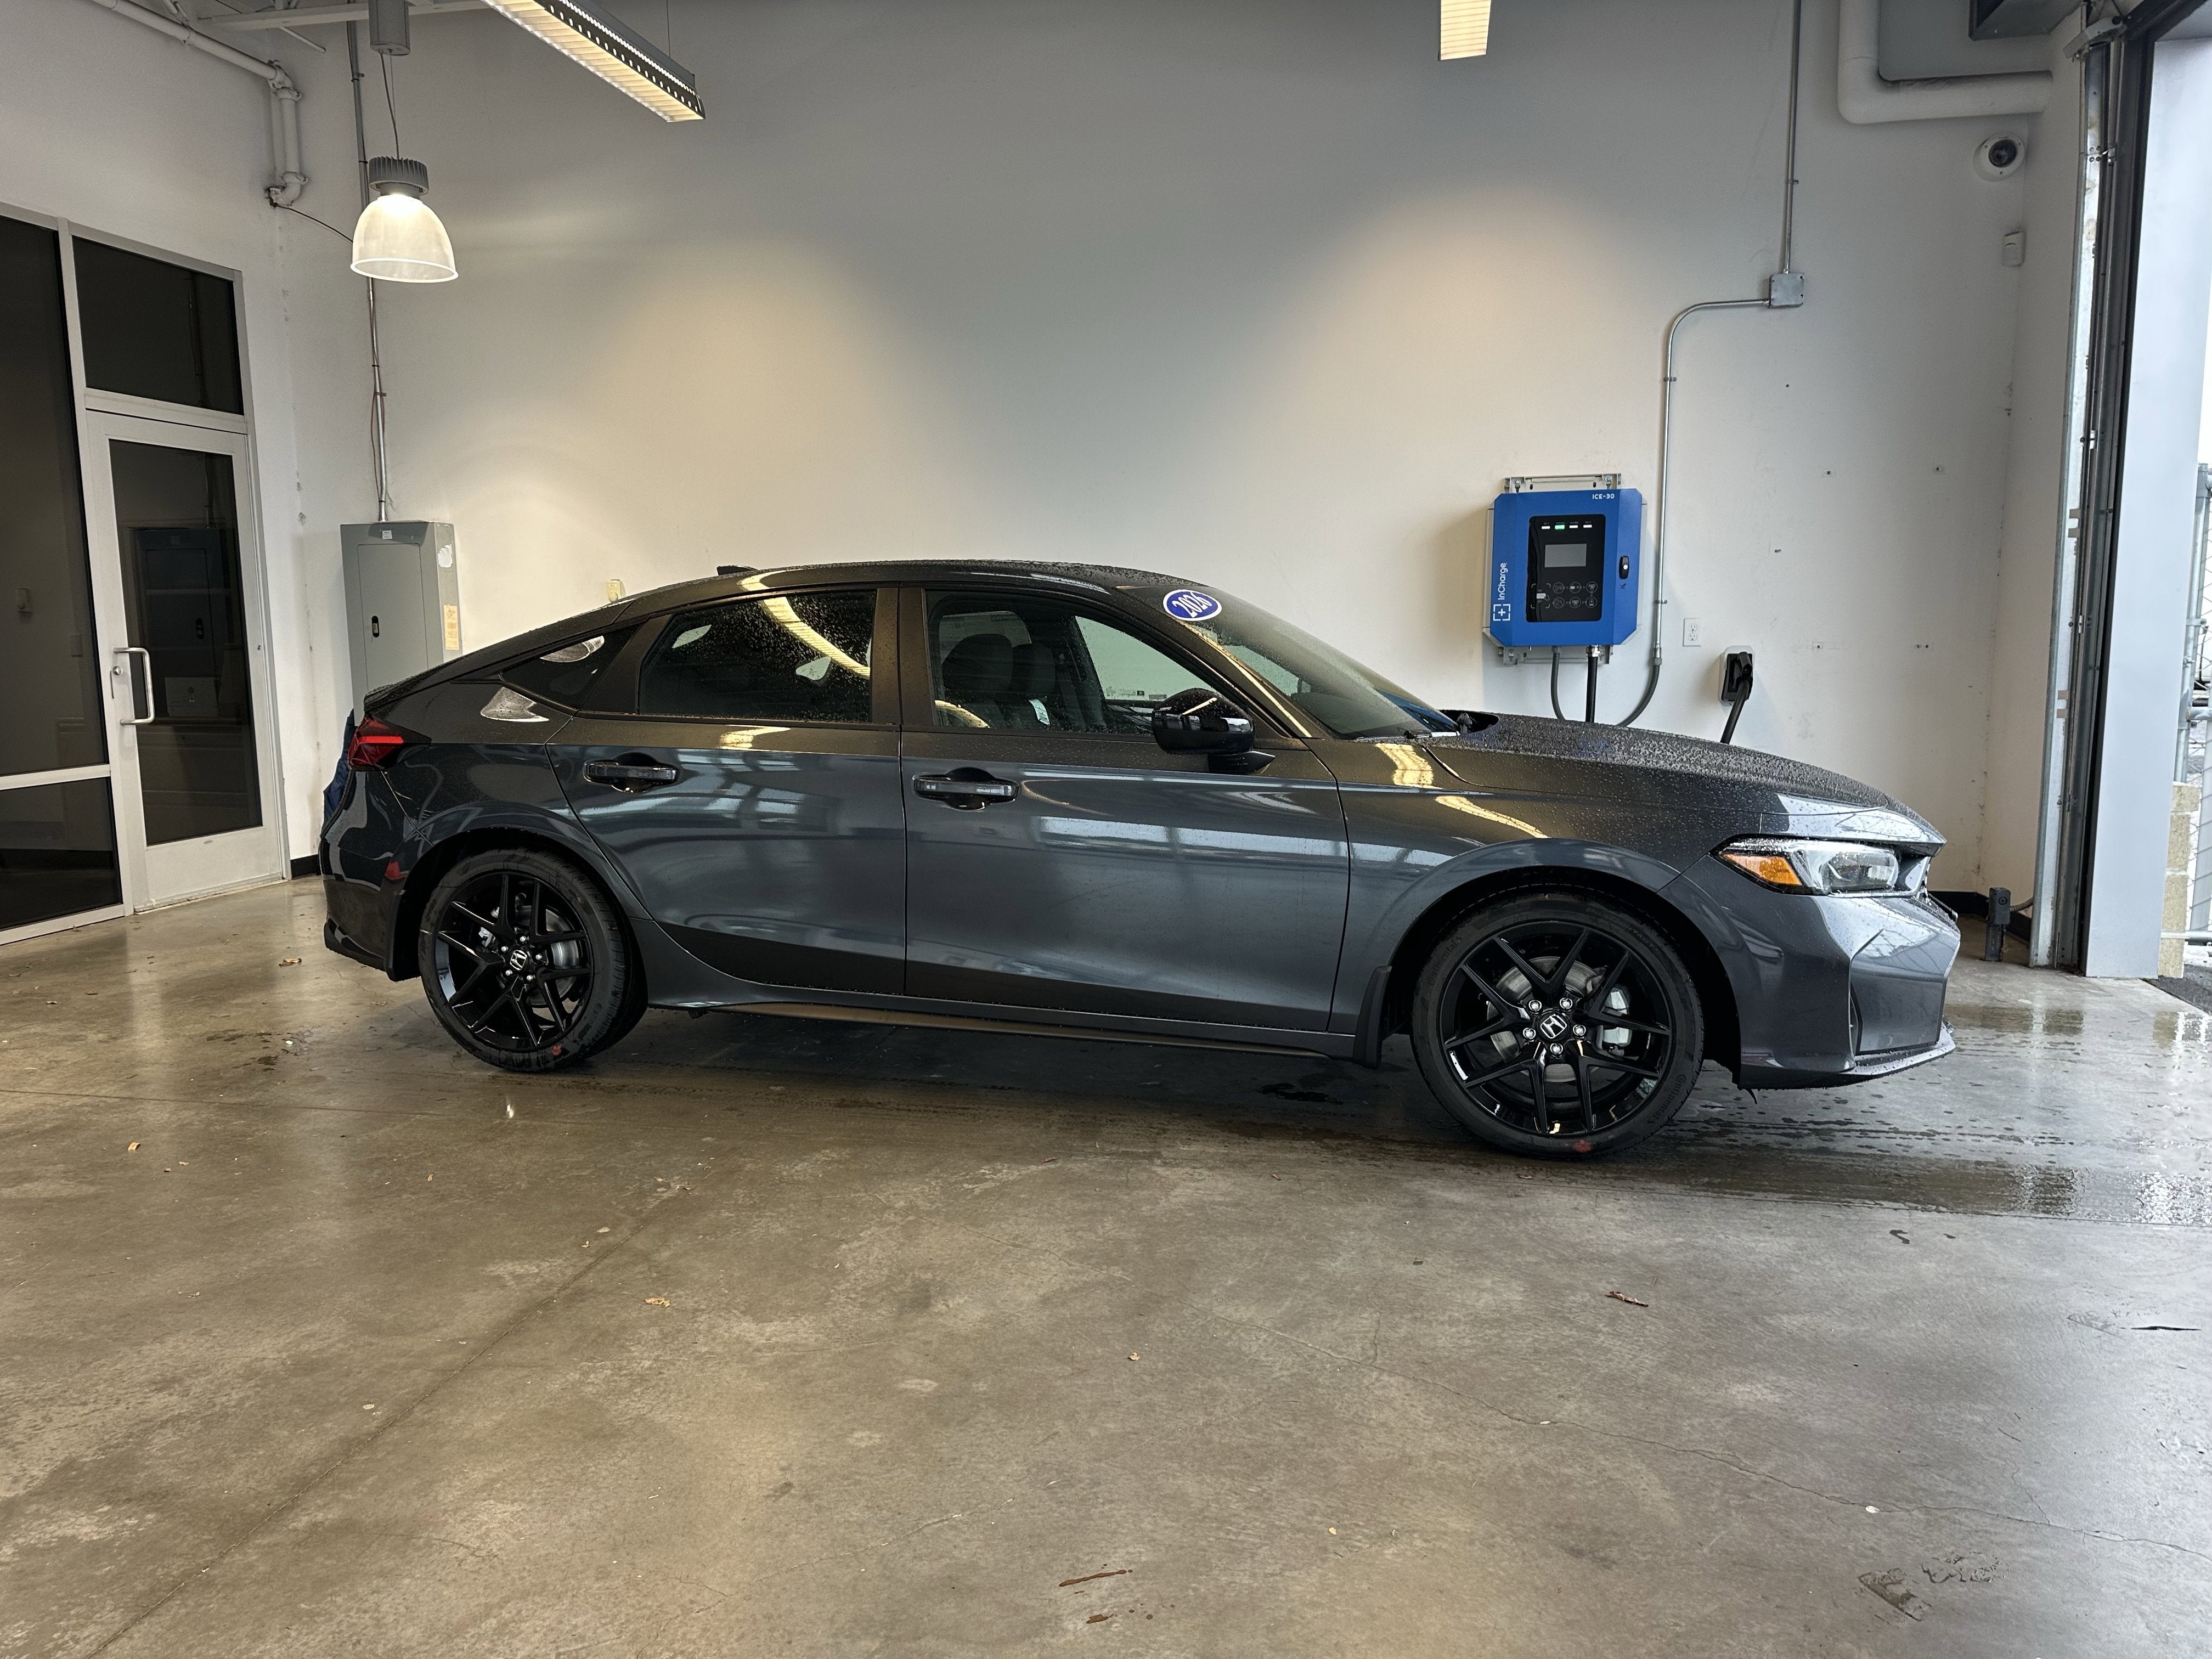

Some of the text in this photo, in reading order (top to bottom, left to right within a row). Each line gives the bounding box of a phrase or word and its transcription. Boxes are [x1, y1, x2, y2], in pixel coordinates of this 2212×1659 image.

[1497, 562, 1508, 600] InCharge
[1172, 591, 1212, 618] 2026
[1652, 1074, 1686, 1120] Continental
